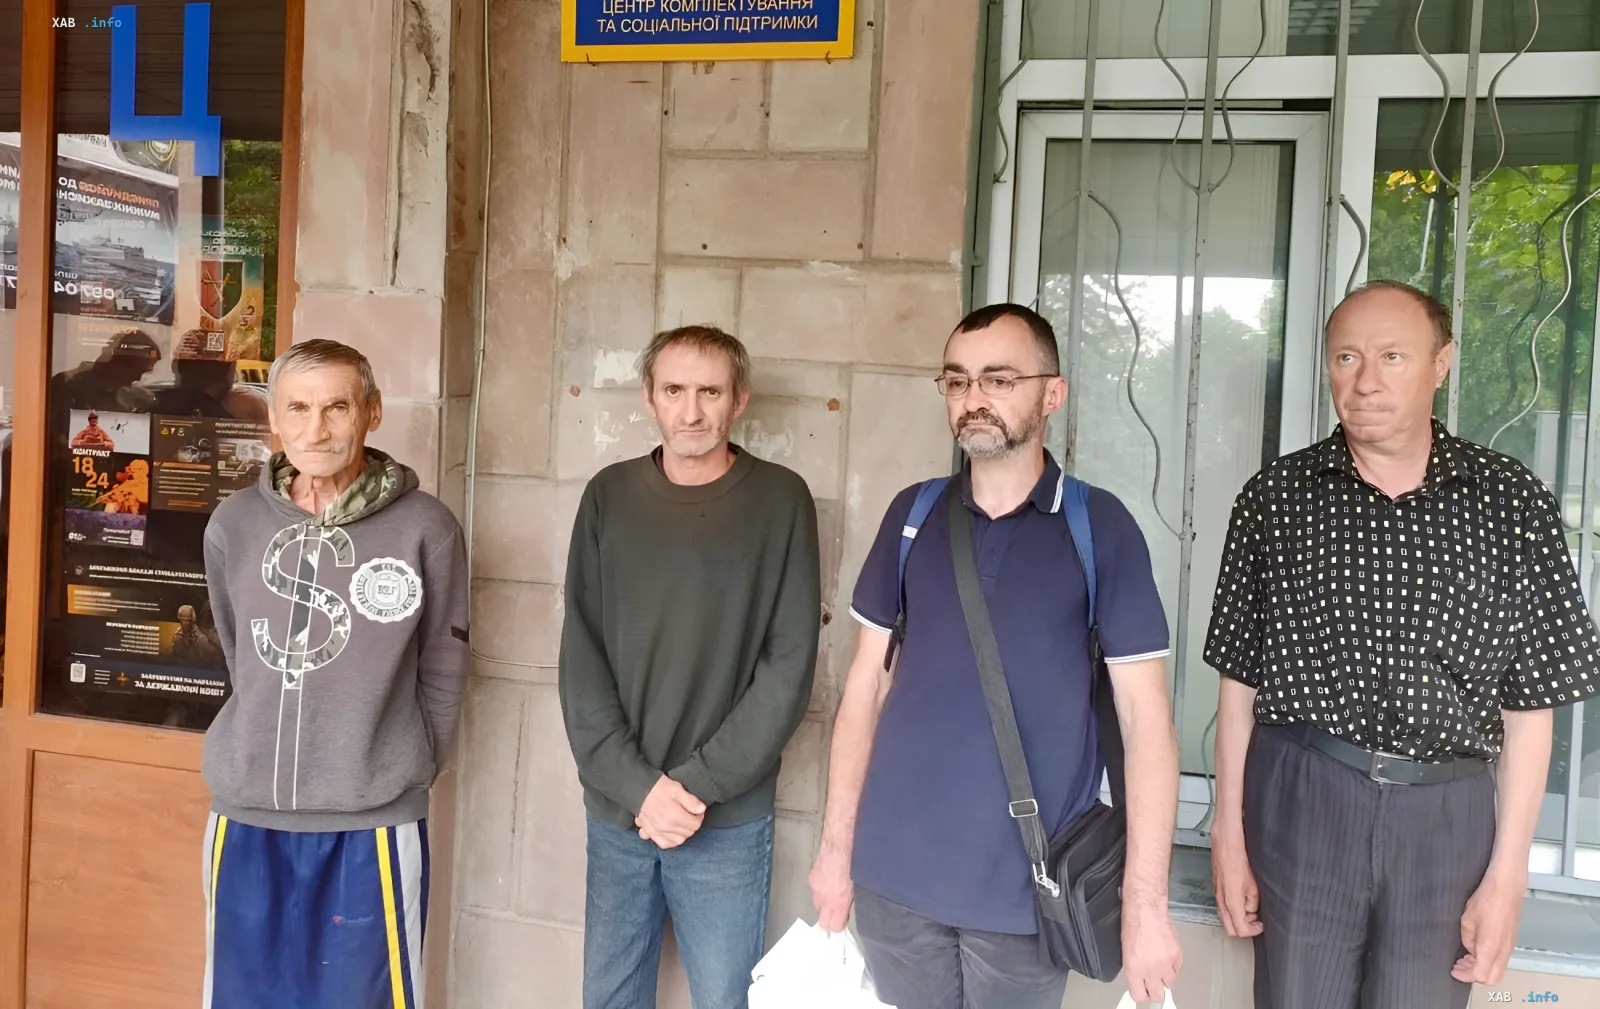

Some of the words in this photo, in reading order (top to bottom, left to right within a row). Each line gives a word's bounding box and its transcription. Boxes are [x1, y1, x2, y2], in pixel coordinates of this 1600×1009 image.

[602, 0, 656, 16] ЦЕНТР
[660, 0, 814, 13] КОМПЛЕКТУВАННЯ
[597, 19, 617, 33] ТА
[620, 15, 721, 35] СОЦІАЛЬНОЇ
[724, 15, 818, 34] ПІДТРИМКИ
[72, 456, 94, 475] 18
[85, 471, 109, 489] 24
